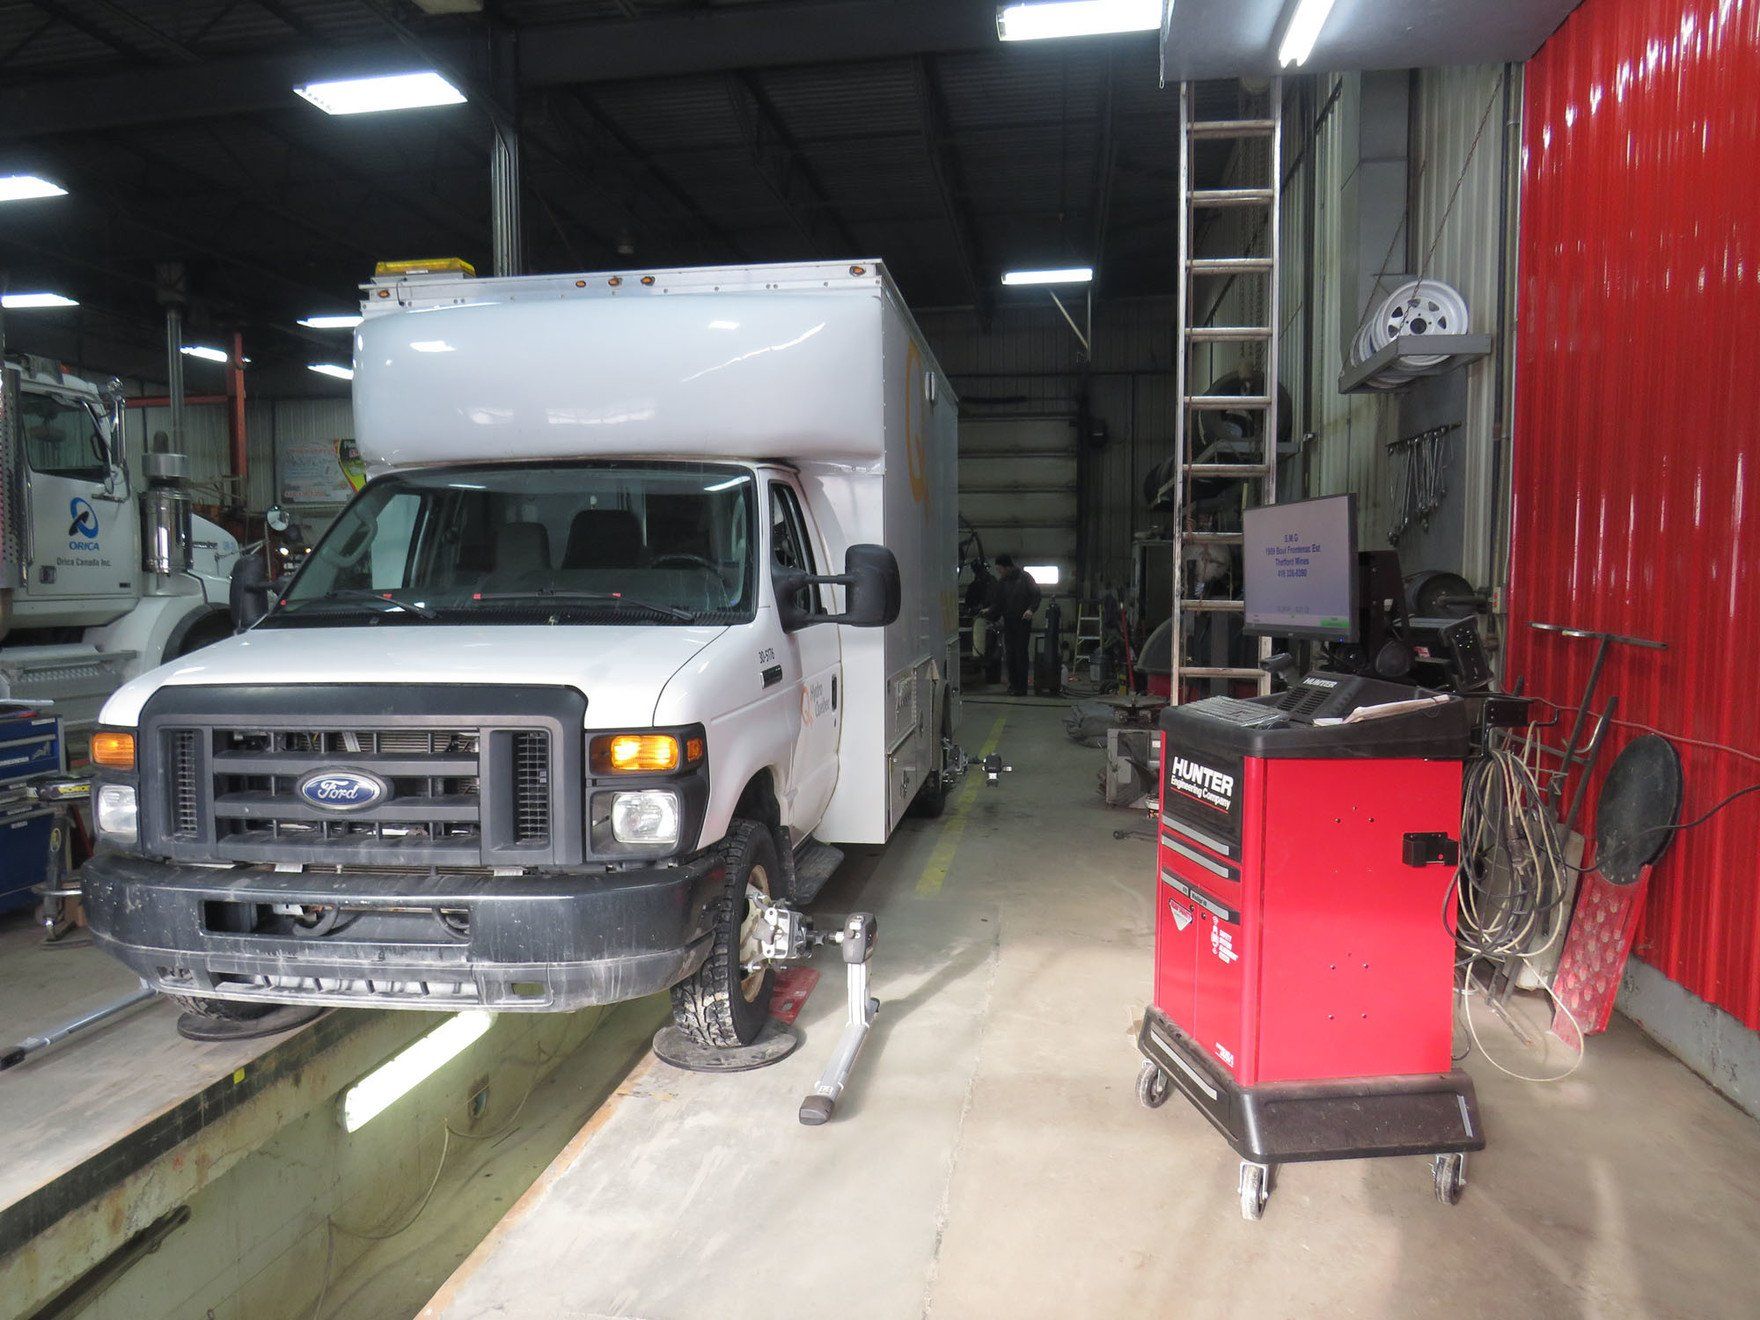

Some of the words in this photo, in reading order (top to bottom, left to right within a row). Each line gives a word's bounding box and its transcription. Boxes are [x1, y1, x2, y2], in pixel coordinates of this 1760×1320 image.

[69, 541, 100, 551] ORICA
[56, 556, 75, 566] Orica
[75, 558, 99, 567] Canada
[1295, 557, 1310, 565] Mines
[1302, 677, 1338, 688] HUNTER
[1172, 756, 1234, 797] HUNTER
[317, 779, 359, 799] Ford
[1170, 774, 1203, 799] Engineering
[1202, 787, 1232, 811] Company
